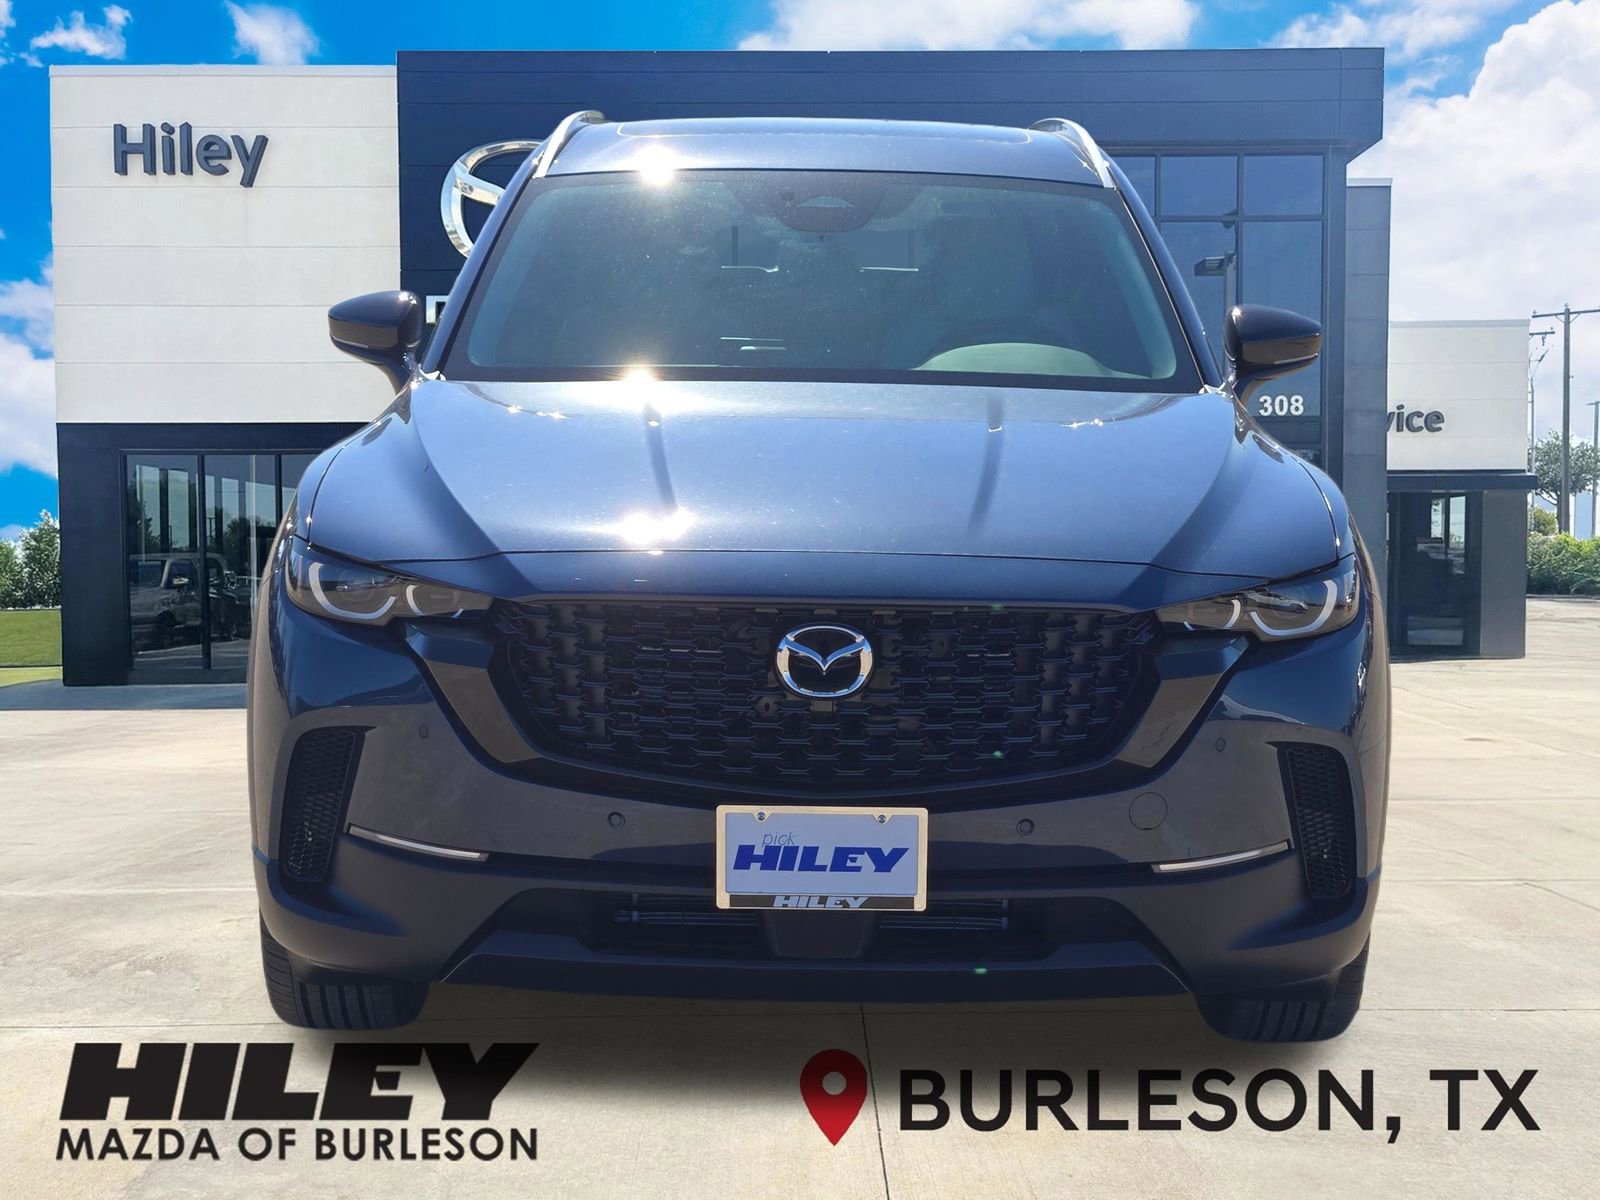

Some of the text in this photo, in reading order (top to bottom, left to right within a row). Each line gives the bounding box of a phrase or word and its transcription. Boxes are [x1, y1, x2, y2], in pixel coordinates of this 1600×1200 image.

[113, 121, 269, 188] Hiley
[1258, 394, 1305, 417] 308
[761, 831, 799, 847] pick
[733, 844, 910, 873] HILEY
[772, 895, 869, 909] HILEY
